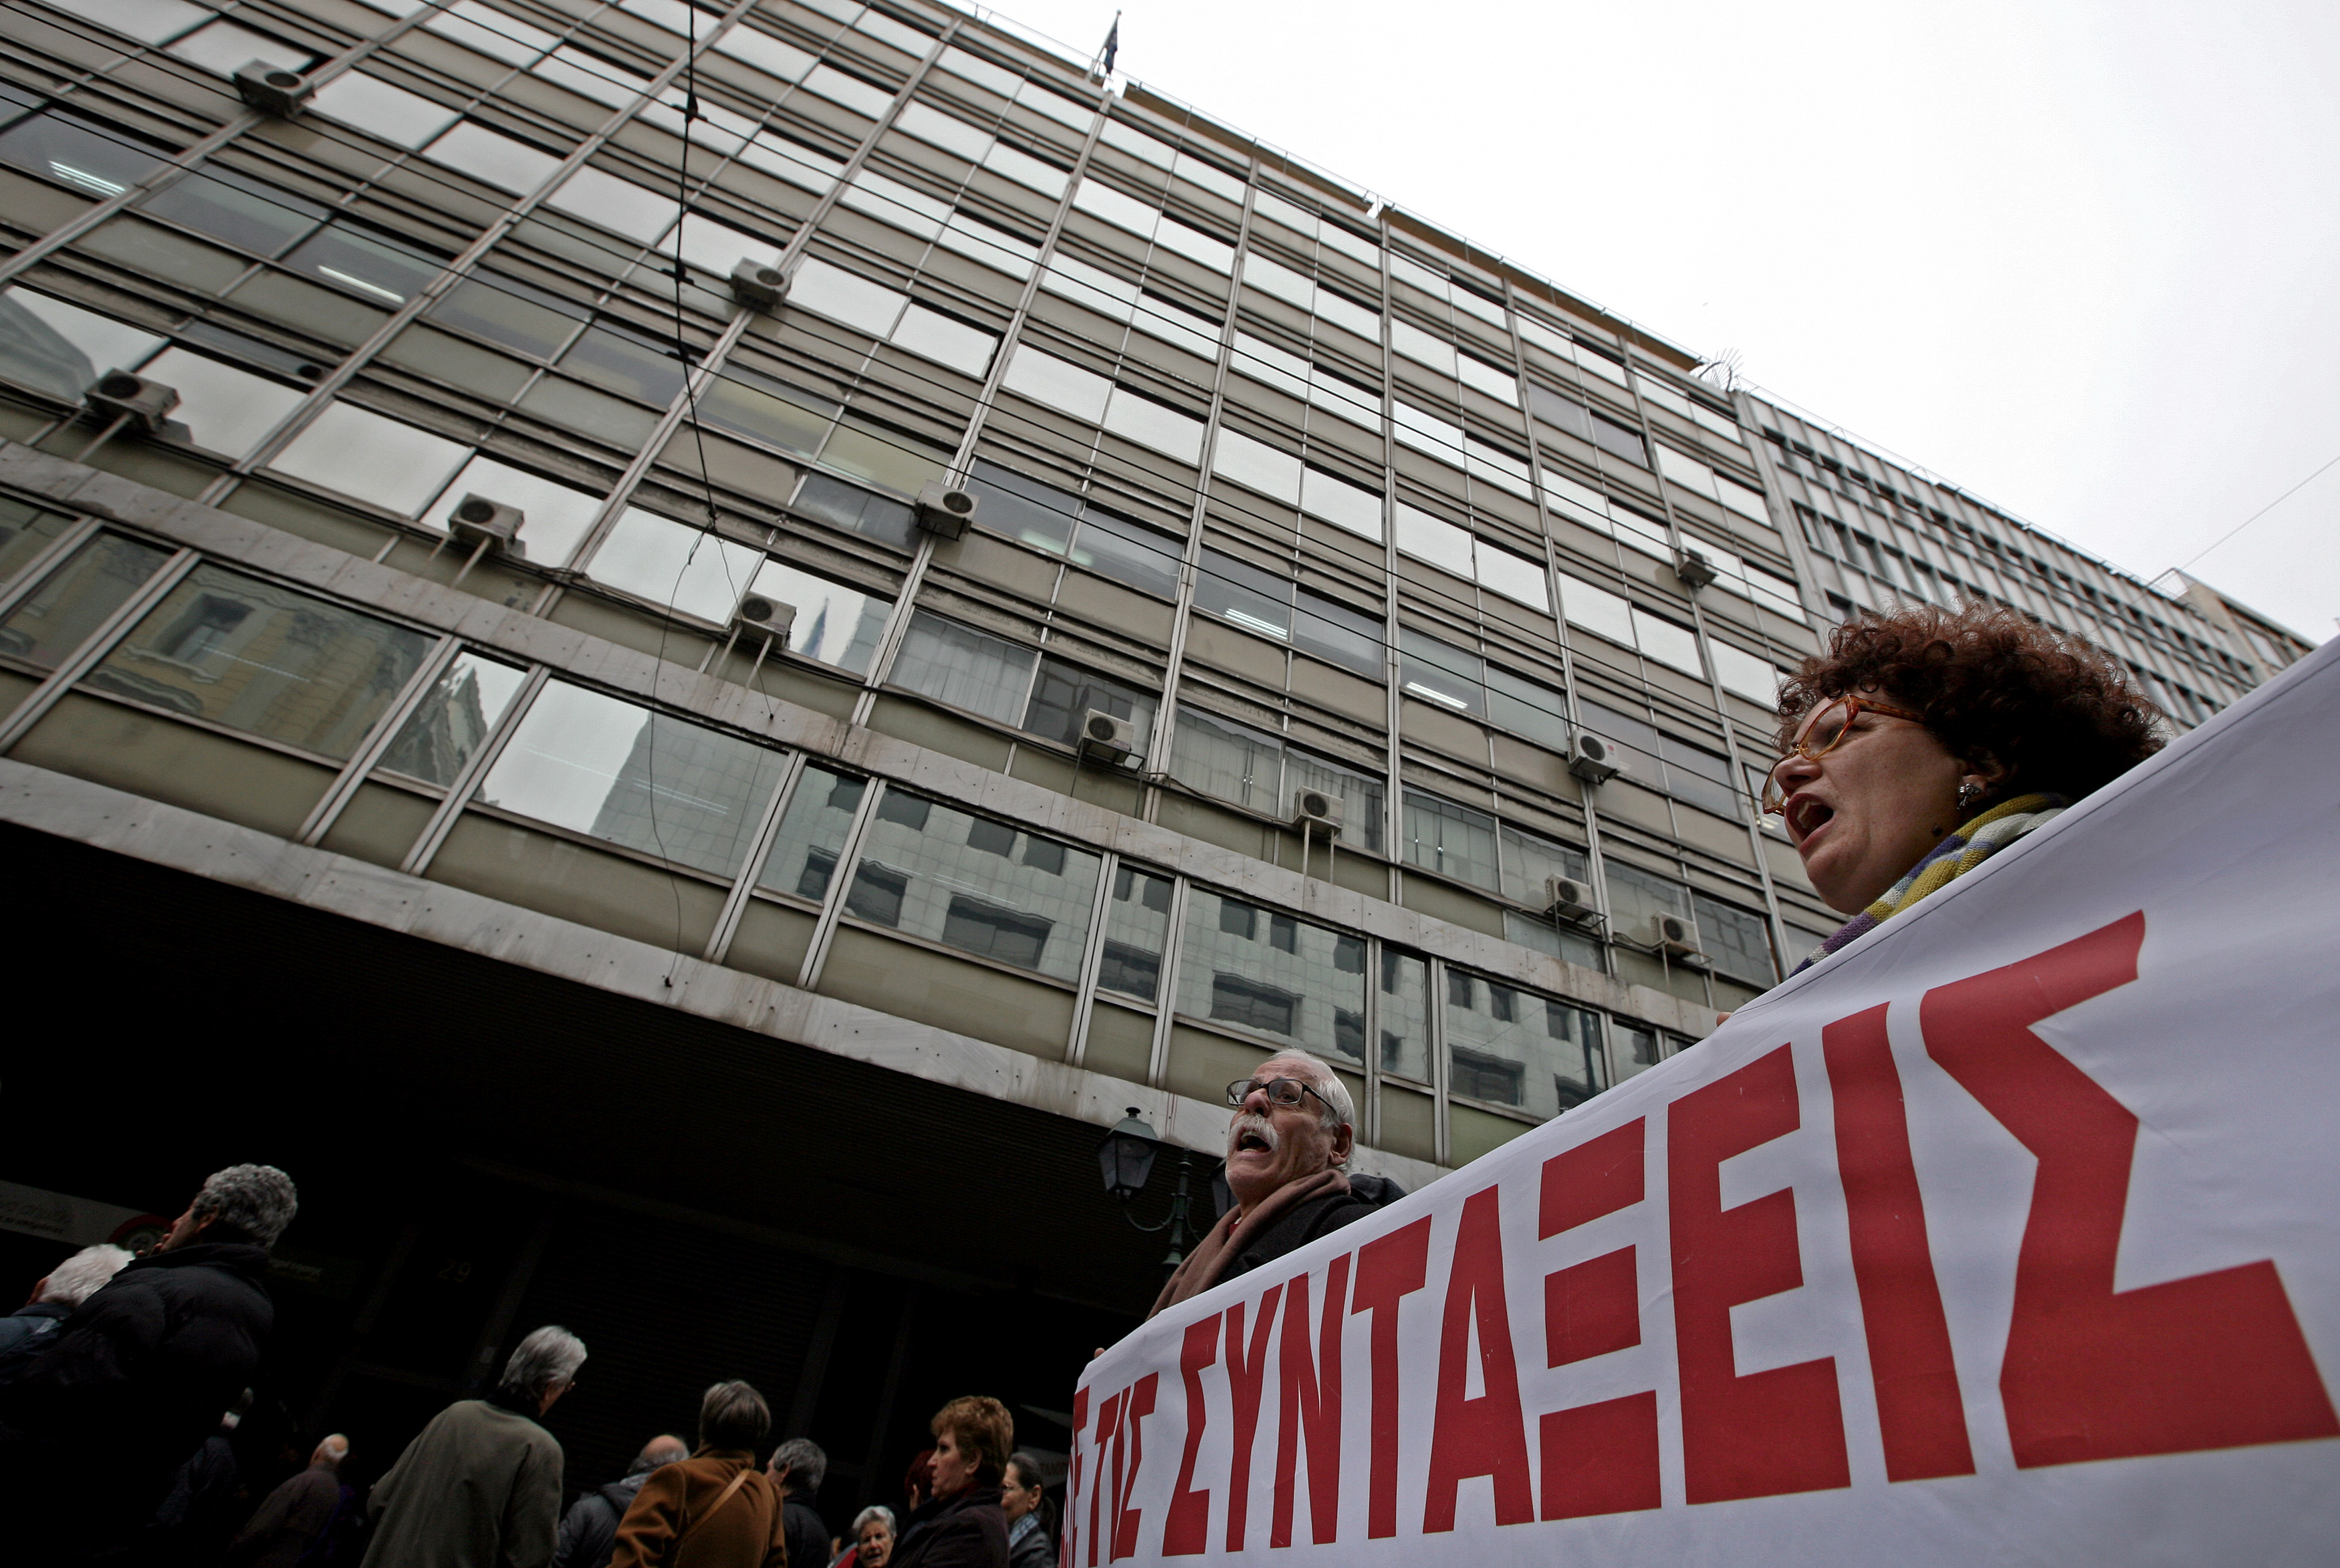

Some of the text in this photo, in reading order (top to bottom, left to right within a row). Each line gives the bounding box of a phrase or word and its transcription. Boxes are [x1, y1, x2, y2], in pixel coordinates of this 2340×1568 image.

[437, 1258, 472, 1283] 29
[1088, 1371, 1159, 1568] ΤΙΣ
[1161, 909, 2340, 1557] ΣΥΝΤΑΞΕΙΣ
